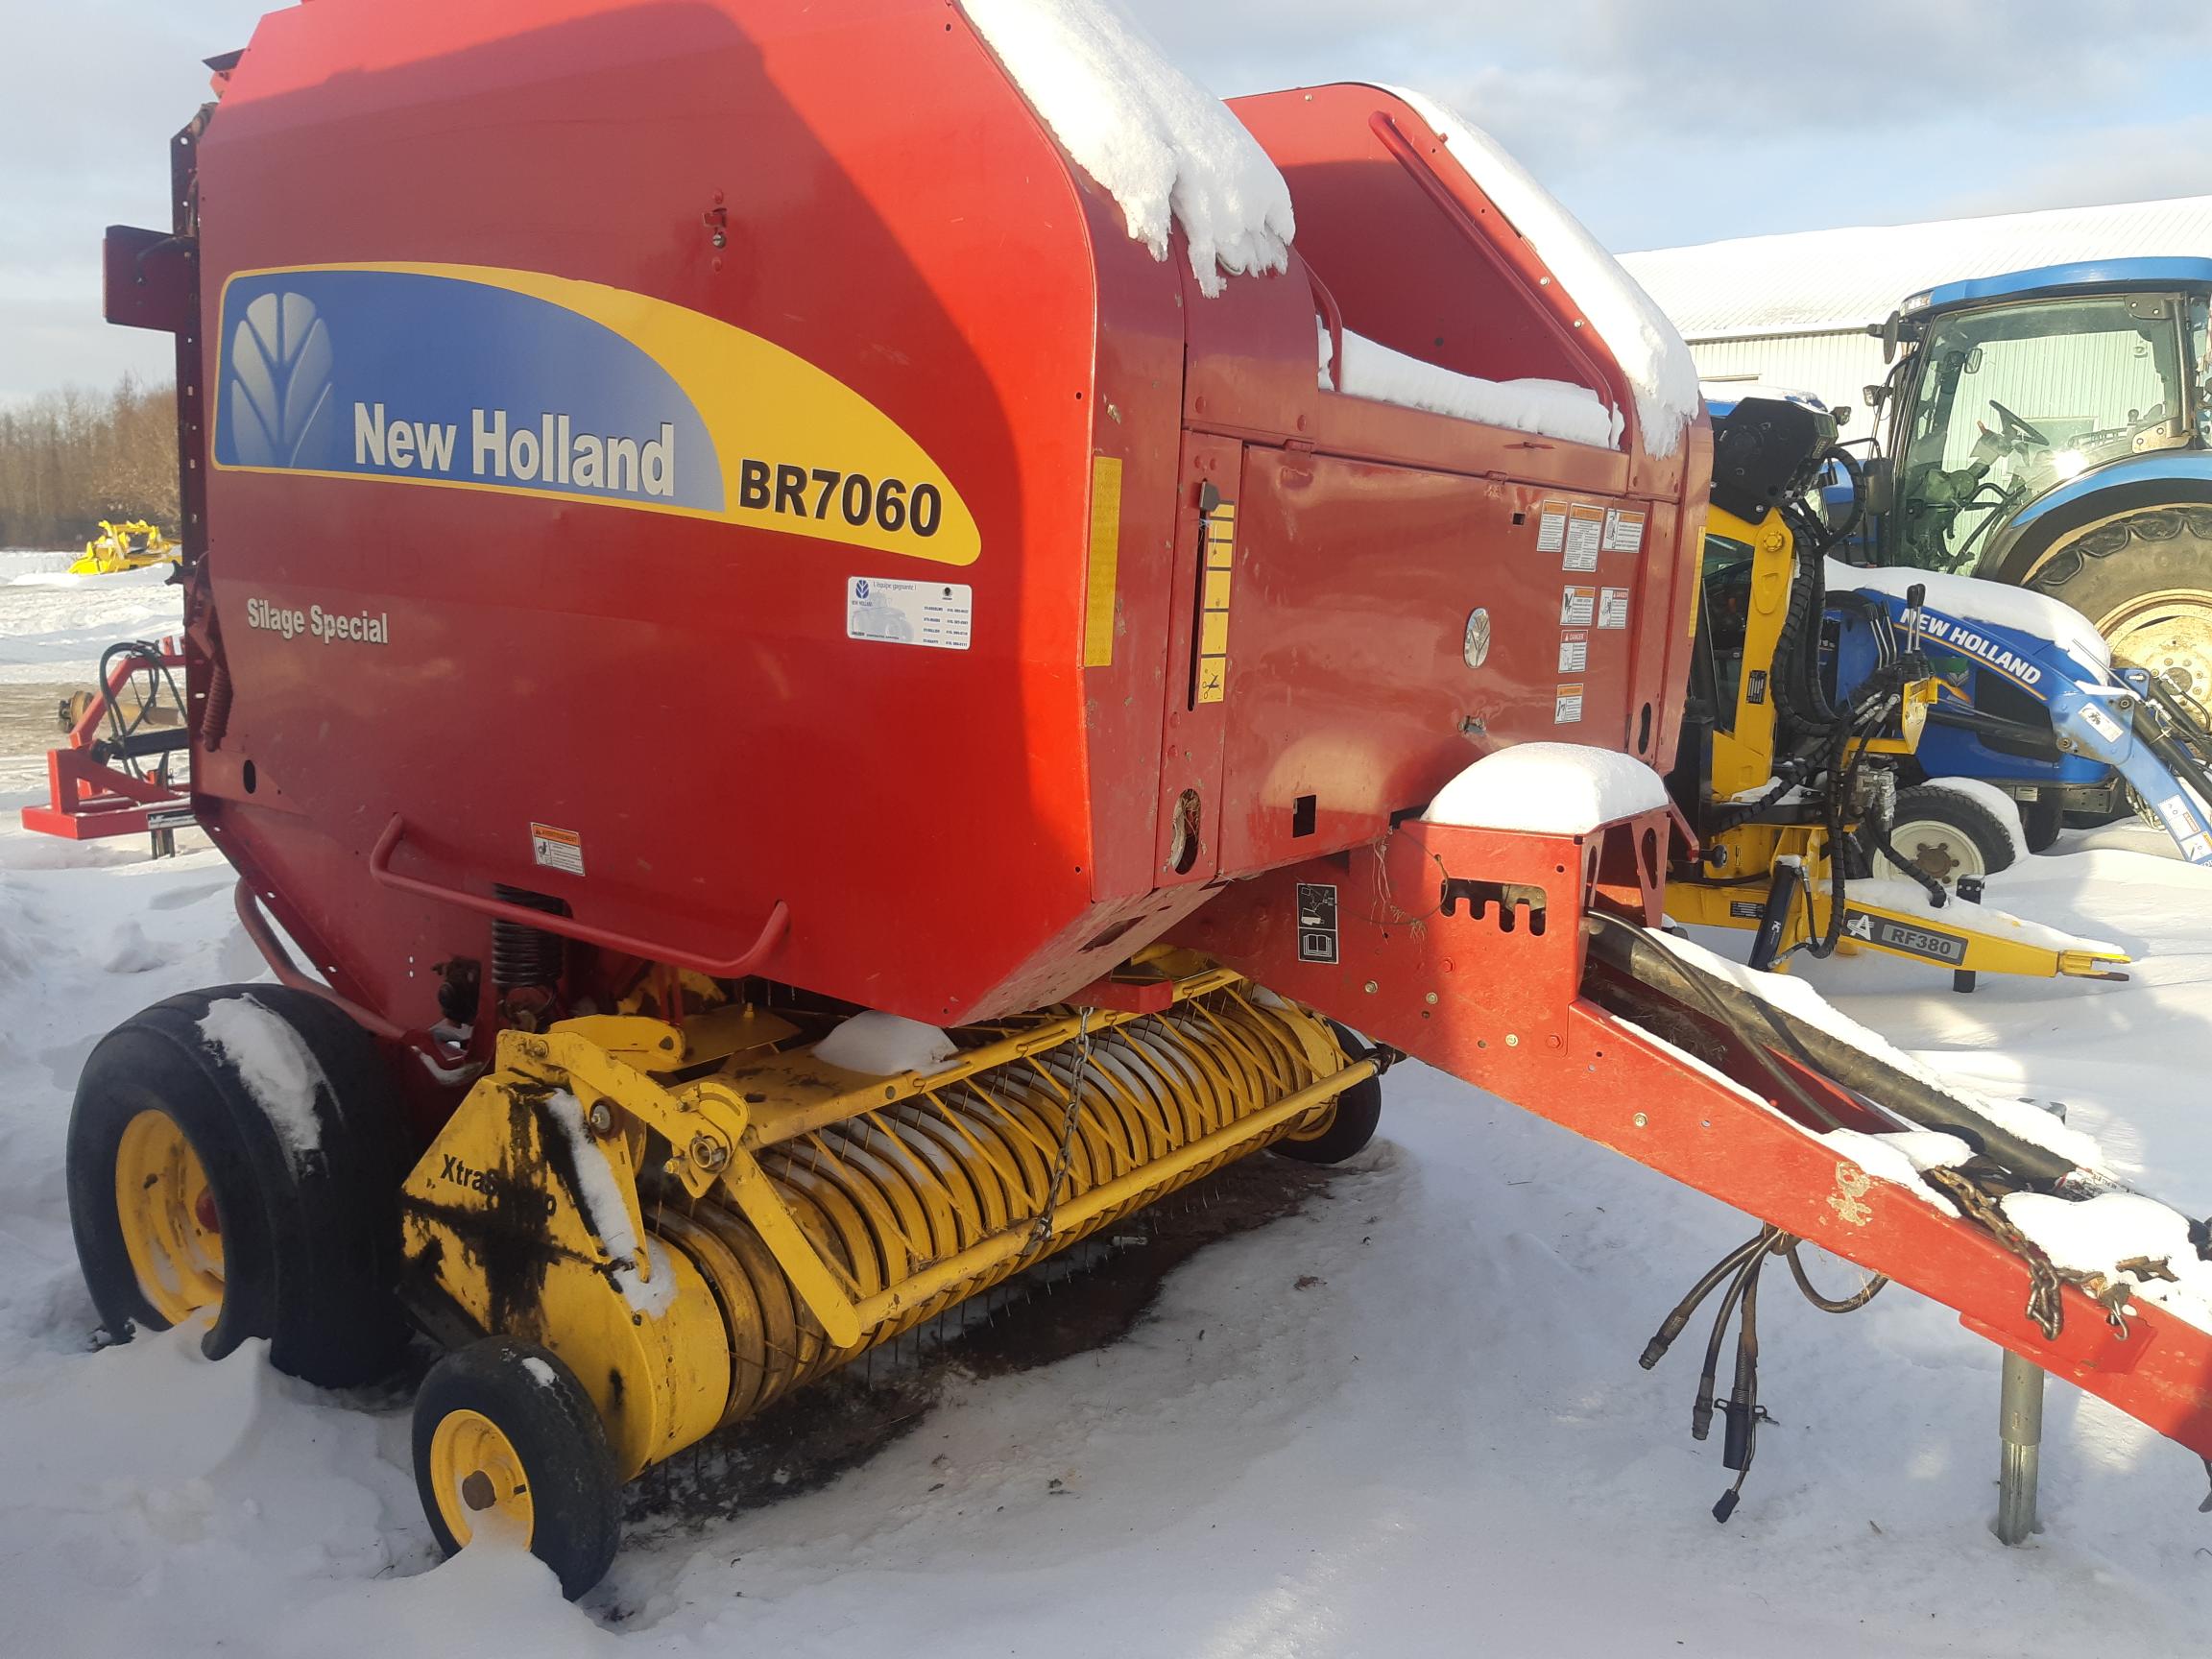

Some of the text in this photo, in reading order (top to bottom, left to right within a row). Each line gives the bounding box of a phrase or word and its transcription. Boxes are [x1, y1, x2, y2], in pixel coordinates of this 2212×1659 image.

[354, 401, 675, 497] New Holland
[739, 459, 942, 538] BR7060
[247, 597, 389, 645] Silage Special
[1899, 607, 2041, 685] NEW HOLLAND
[1891, 927, 1951, 955] RF380
